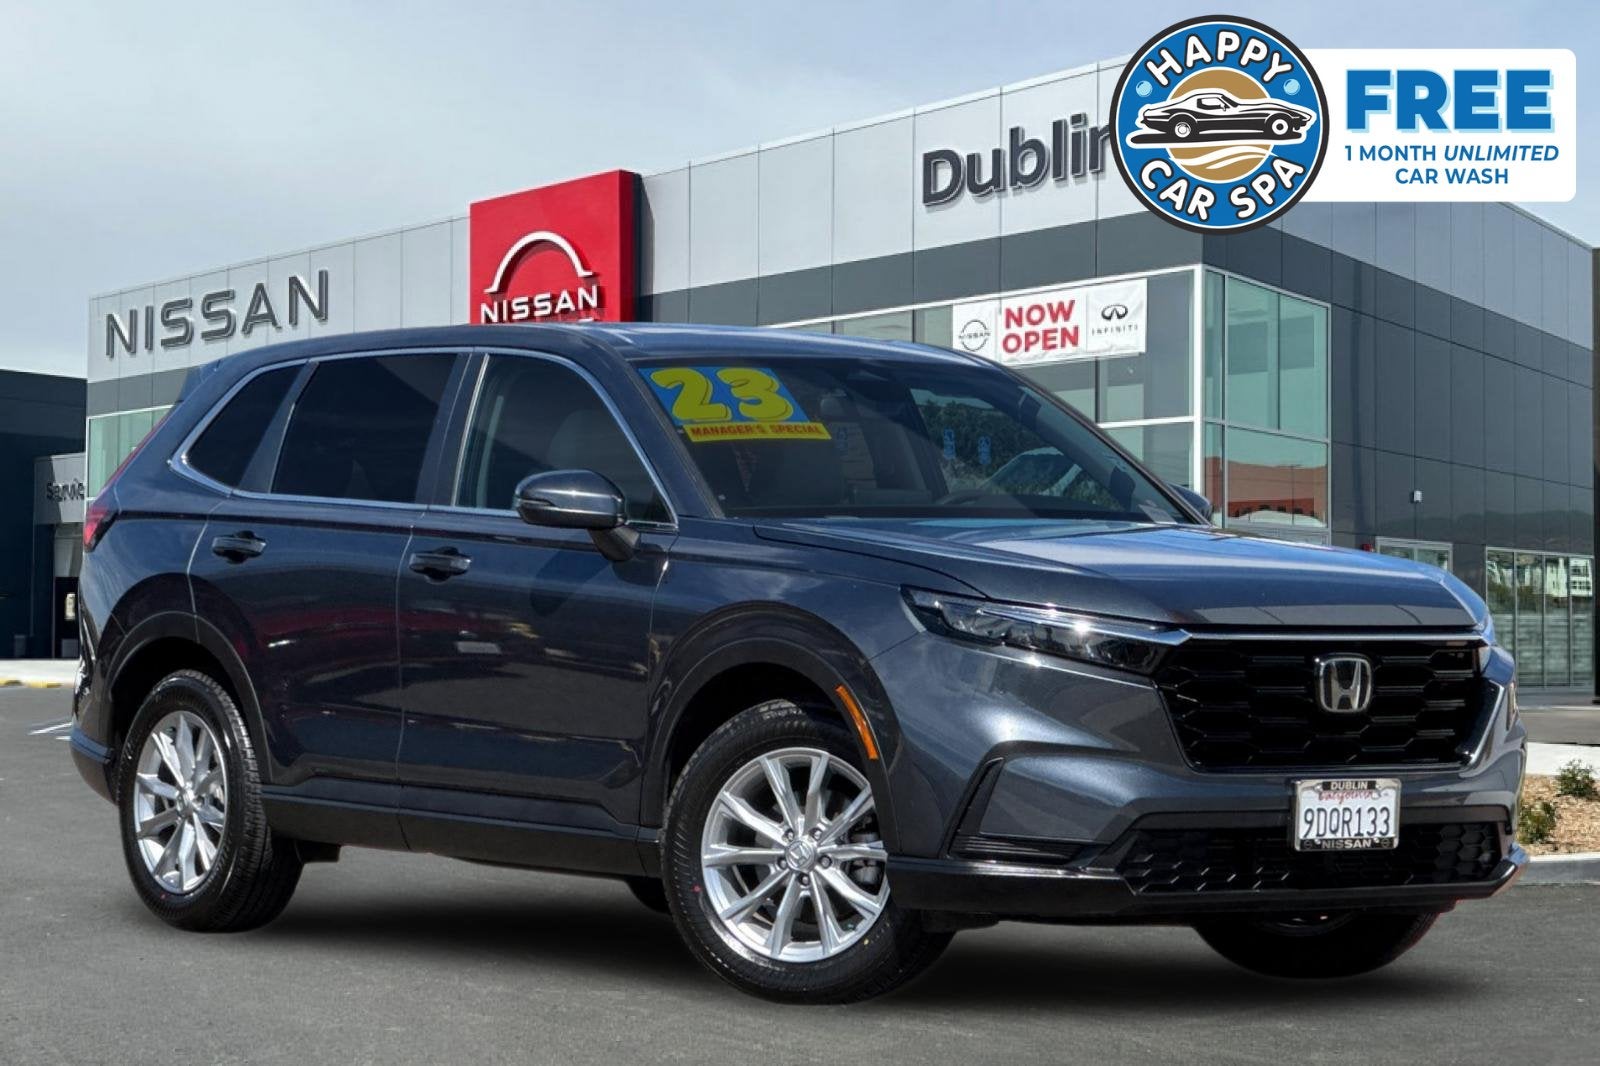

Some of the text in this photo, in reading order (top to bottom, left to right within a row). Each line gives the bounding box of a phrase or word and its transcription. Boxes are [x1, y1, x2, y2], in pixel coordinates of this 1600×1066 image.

[106, 270, 329, 358] NISSAN
[480, 284, 598, 324] NISSAN
[1005, 300, 1075, 330] NOW
[1002, 325, 1079, 354] OPEN
[1092, 324, 1138, 336] INFINITI
[651, 368, 793, 422] 23
[691, 424, 824, 436] MANAGER'S SPECIAL
[1330, 782, 1368, 790] DUBLIN
[1321, 840, 1372, 849] NISSAN
